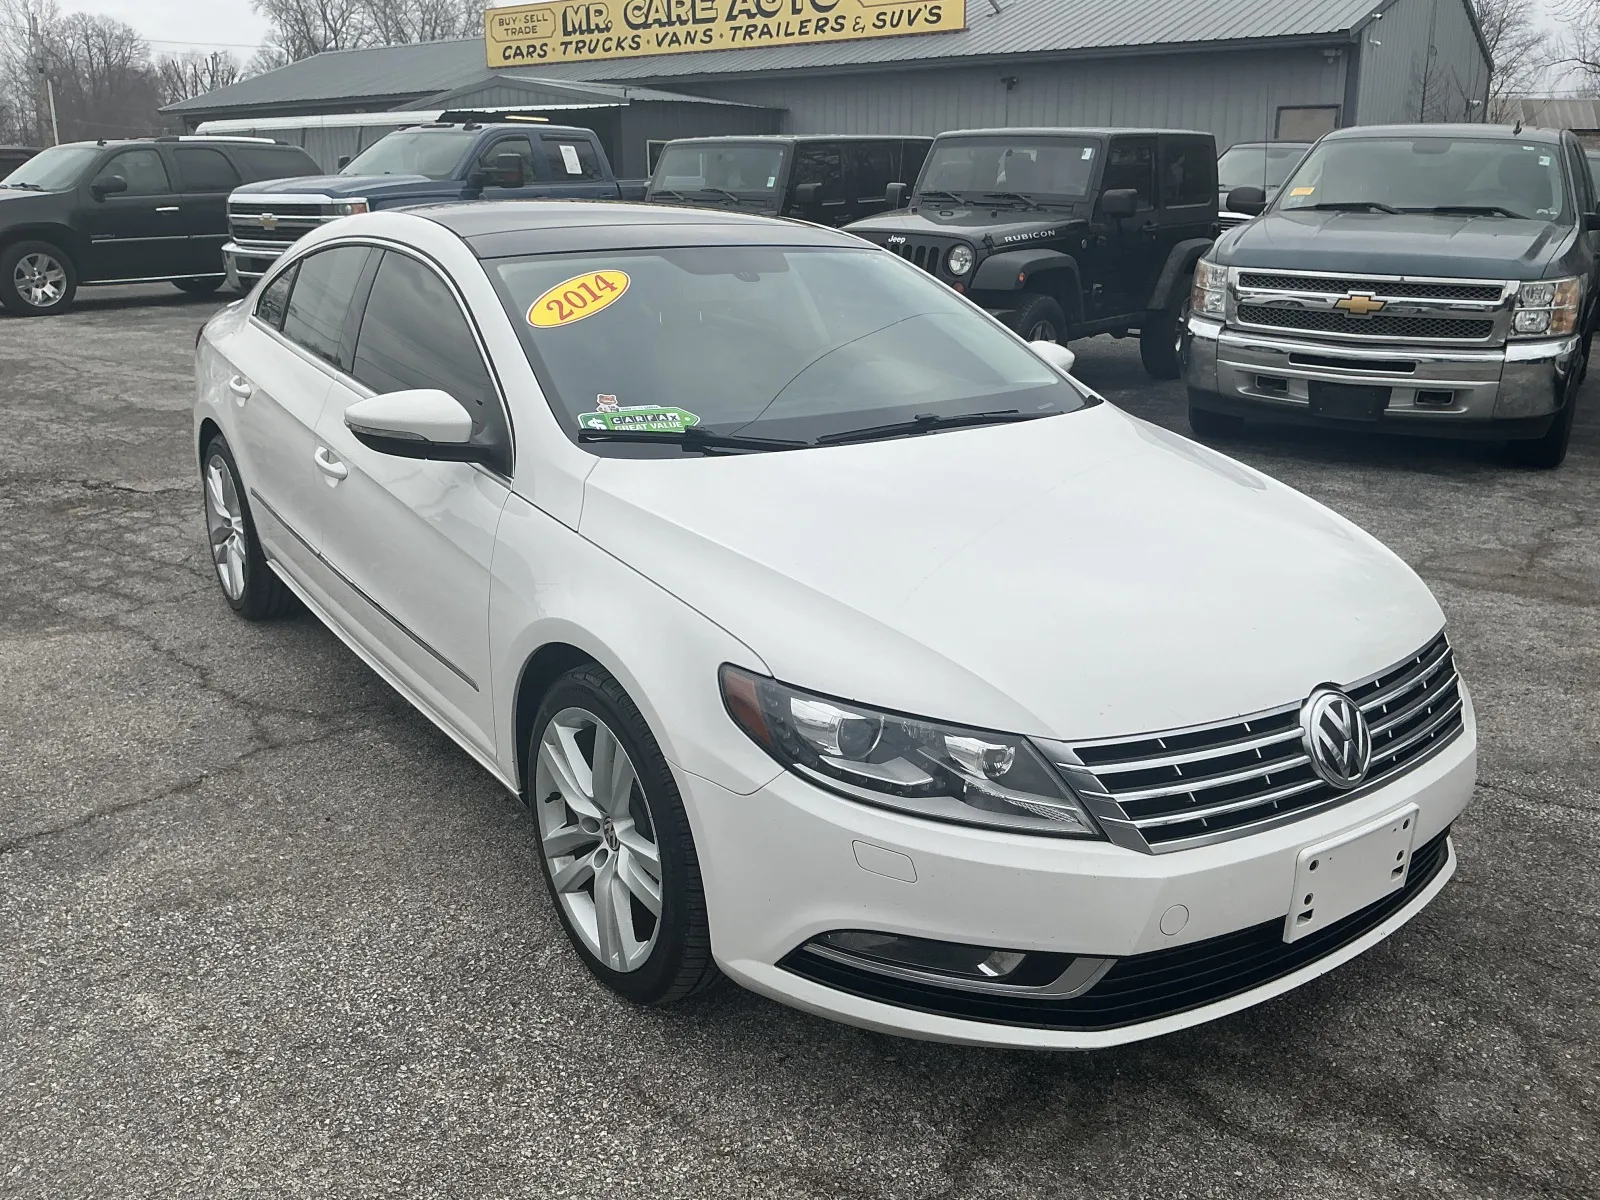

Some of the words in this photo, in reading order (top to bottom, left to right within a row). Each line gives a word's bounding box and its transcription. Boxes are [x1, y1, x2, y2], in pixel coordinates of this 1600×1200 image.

[498, 17, 518, 27] BUY
[523, 13, 549, 24] SELL
[562, 2, 613, 37] MR.
[623, 0, 721, 31] CARE
[502, 42, 549, 61] CARS
[560, 34, 642, 56] TRUCKS
[655, 28, 714, 48] VANS
[729, 15, 847, 42] TRAILERS
[853, 16, 866, 34] &
[872, 4, 942, 30] SUV'S
[504, 25, 538, 37] TRADE
[888, 235, 906, 244] Jeep
[1003, 230, 1057, 243] RUBICON
[546, 275, 618, 321] 2014
[612, 413, 680, 424] CARFAX
[614, 423, 648, 431] GREAT
[649, 421, 684, 430] VALUE
